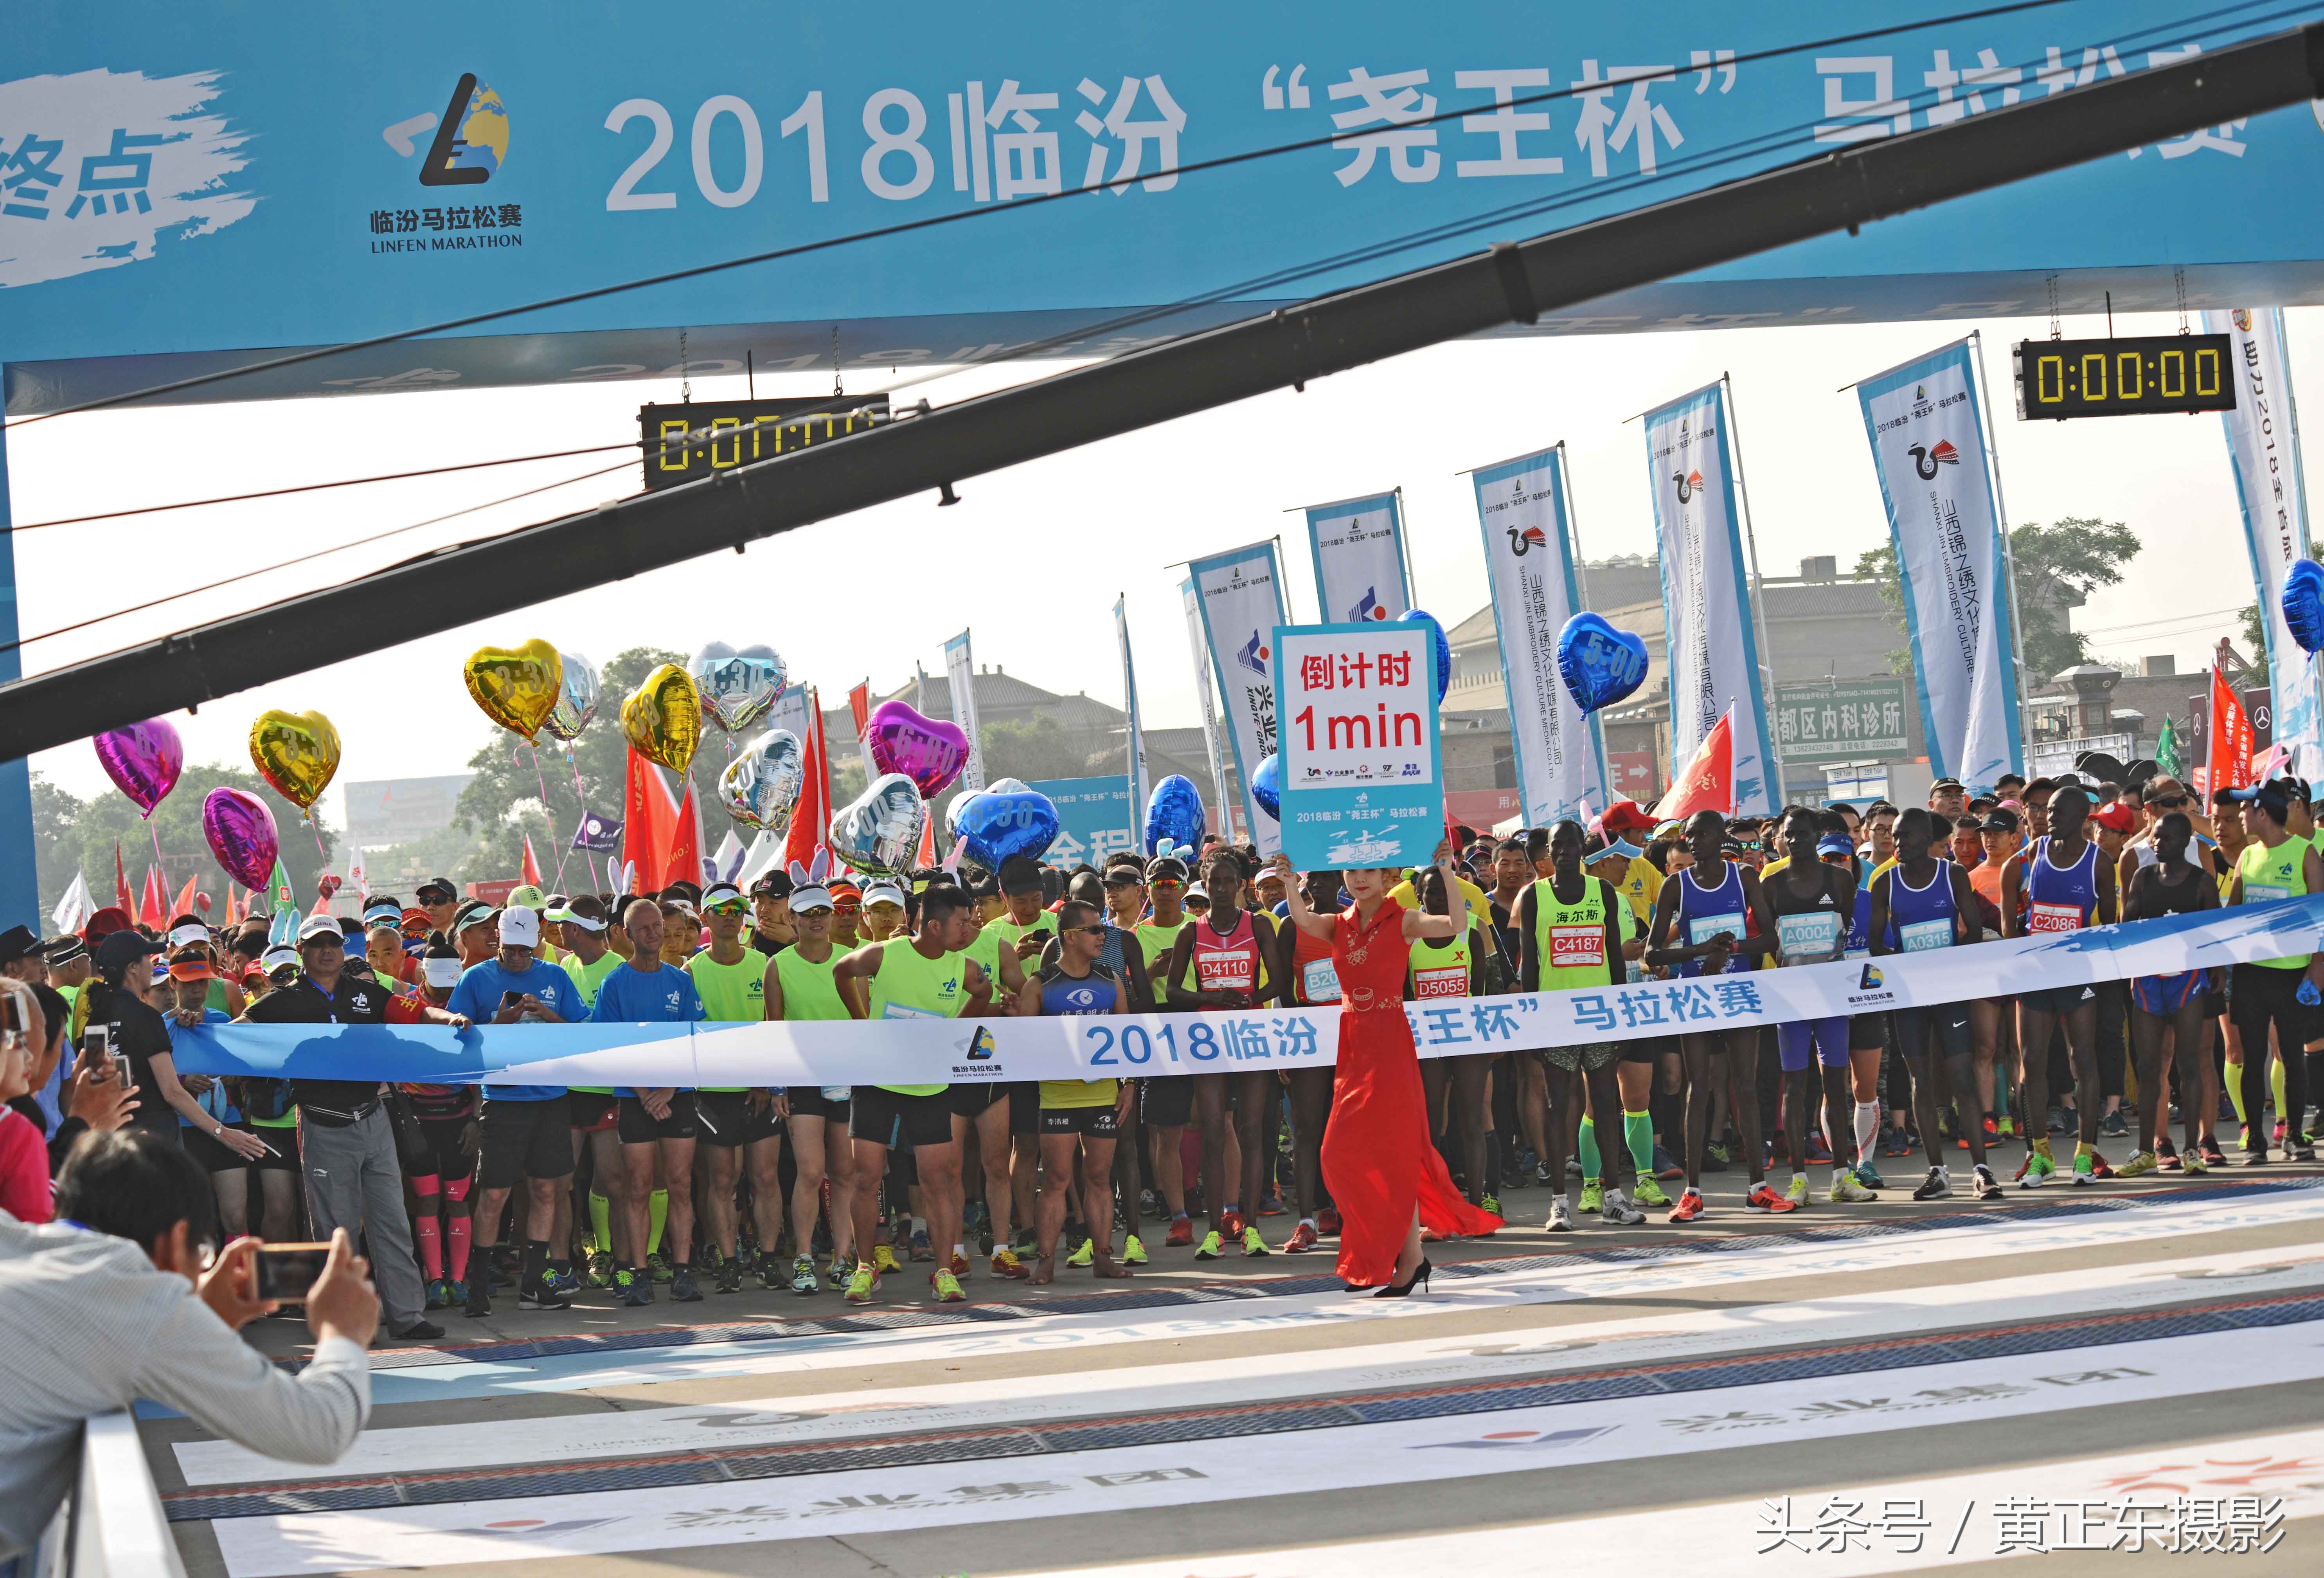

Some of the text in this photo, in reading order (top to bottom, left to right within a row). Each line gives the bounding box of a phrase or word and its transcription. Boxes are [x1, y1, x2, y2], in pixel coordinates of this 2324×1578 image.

[604, 74, 1187, 211] 2018临汾
[0, 128, 162, 220] 终点
[370, 204, 522, 235] 临汾马拉松赛
[371, 234, 522, 254] LINFEN MARATHON
[2038, 349, 2220, 403] 0:00:00
[1930, 491, 1974, 675] SHANXI JIN EMBROIDERY CULTURE
[1519, 566, 1529, 598] SHANXI
[1527, 616, 1541, 672] EMBROIDERY
[1536, 675, 1547, 716] CULTURE
[1584, 632, 1642, 686] 5:00
[495, 658, 557, 700] 3:30
[703, 661, 764, 695] 4:30
[1300, 650, 1412, 692] 倒计时
[1529, 573, 1562, 766] 山西锦之绣文化传媒有限公司
[961, 710, 976, 760] FITNESS
[1245, 686, 1268, 760] XINGYE GROU
[1295, 703, 1422, 751] 1min
[1872, 740, 1898, 748] 2228342
[282, 727, 337, 763] 3:30
[894, 724, 957, 776] 6:00
[968, 799, 1034, 830] 5:30
[1556, 909, 1599, 924] 海尔斯
[1786, 924, 1831, 942] A0004
[2034, 915, 2077, 931] C2086
[1554, 937, 1600, 952] C4187
[1907, 931, 1950, 952] A0315
[1201, 960, 1248, 976] D4110
[1419, 978, 1465, 996] D5055
[1848, 992, 1894, 1004] 临汾马拉松赛
[1086, 1016, 1318, 1065] 2018临汾
[1570, 980, 1764, 1031] 马拉松赛
[952, 1064, 1002, 1074] 临汾马拉松赛
[1660, 1367, 2157, 1429] 兴业集团
[664, 1467, 1209, 1520] 兴业集团
